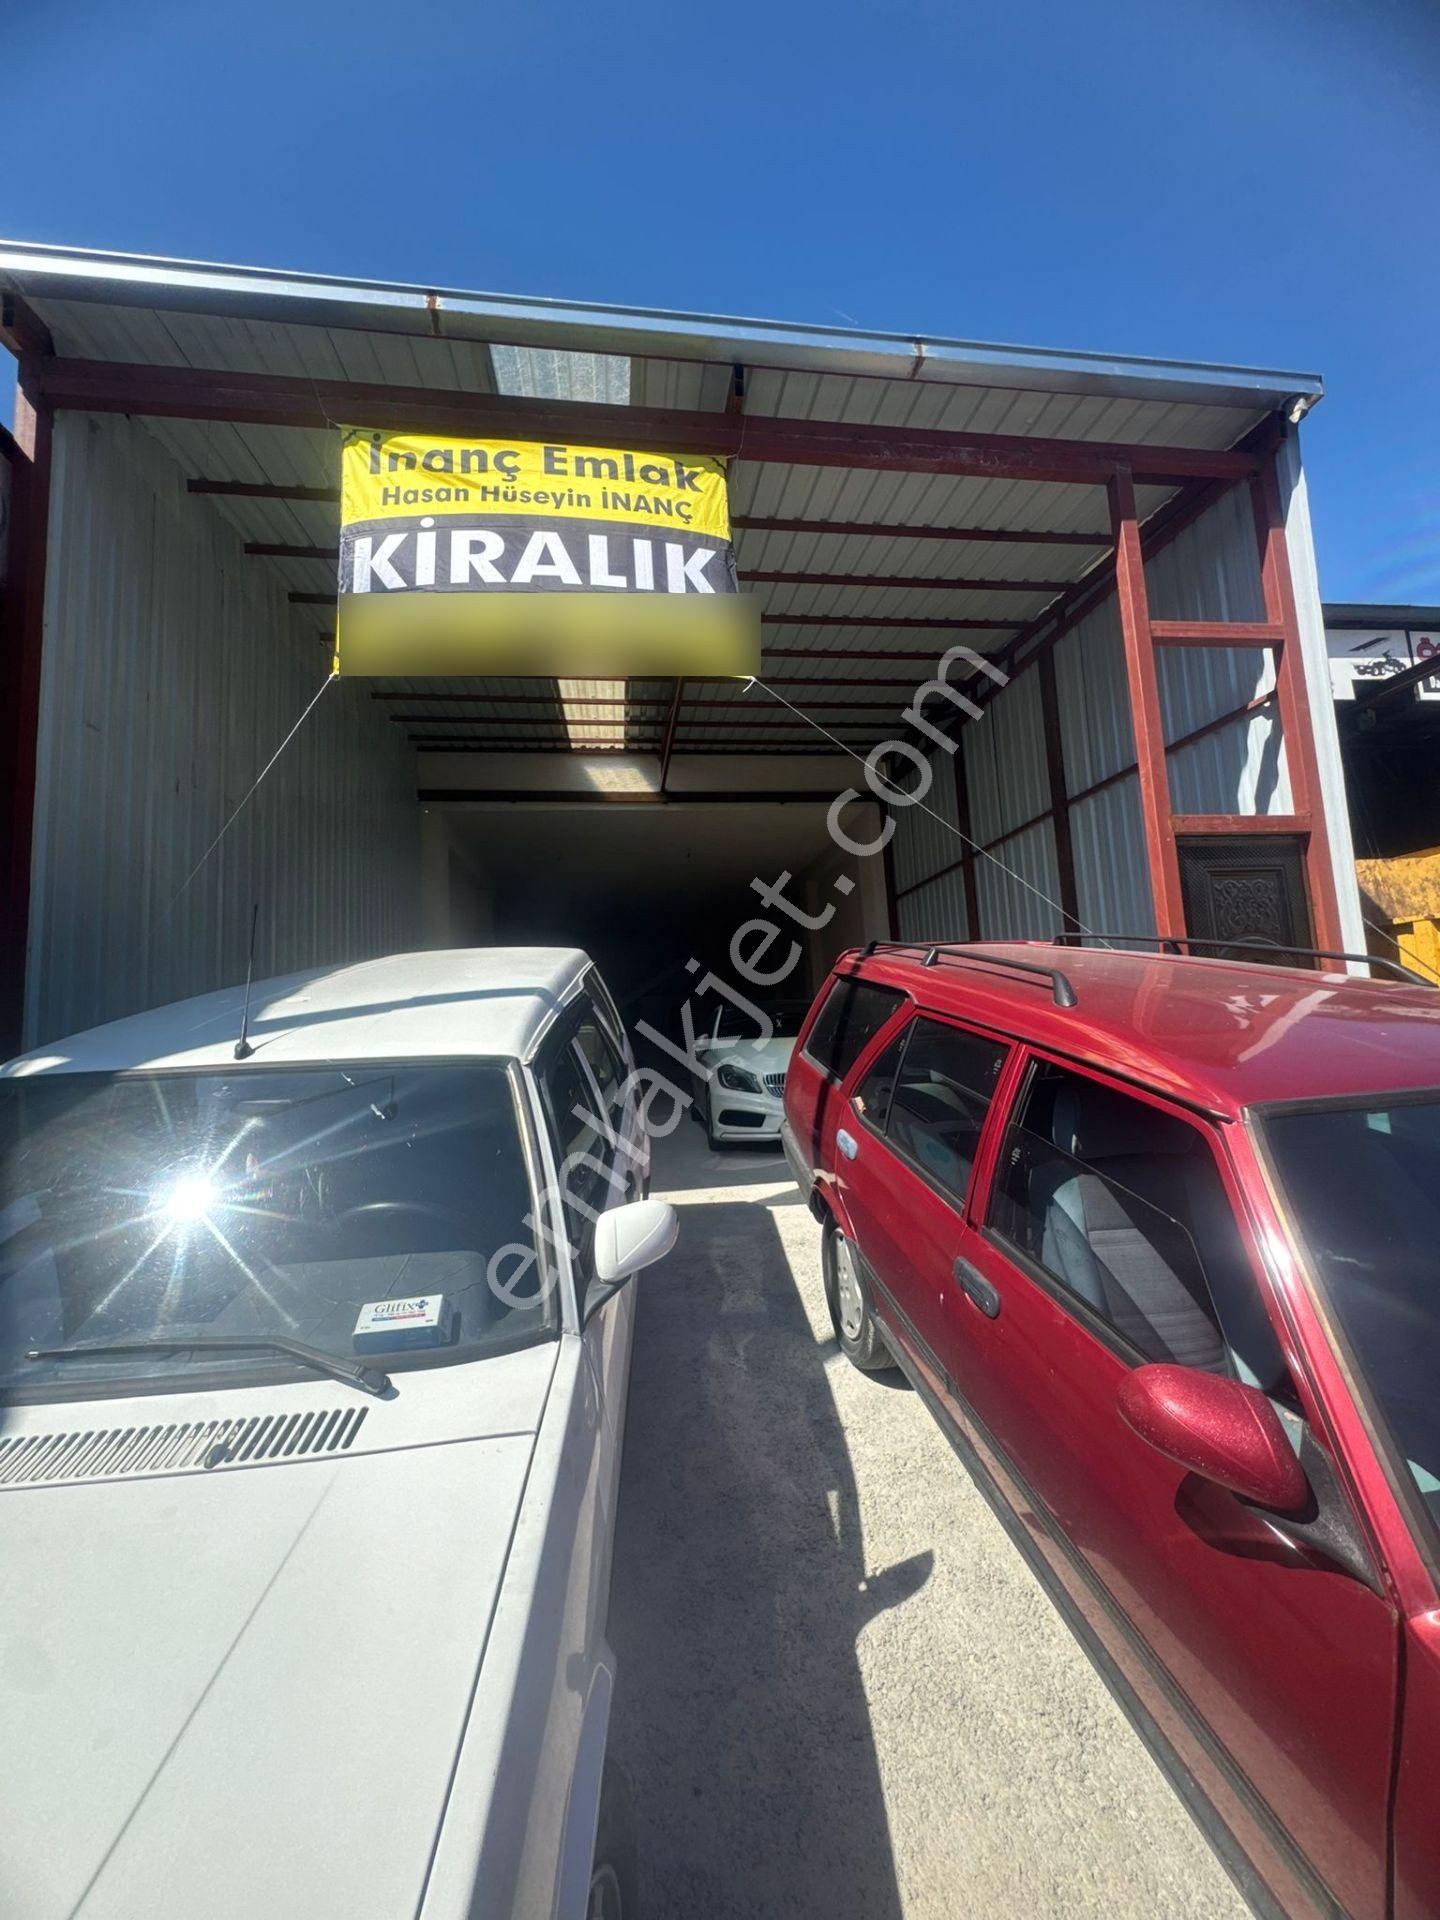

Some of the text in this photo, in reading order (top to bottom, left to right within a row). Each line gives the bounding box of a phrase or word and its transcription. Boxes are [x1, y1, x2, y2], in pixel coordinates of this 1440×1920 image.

[370, 433, 703, 493] İnanç Emlak
[382, 485, 693, 523] Hasan Hüseyin İNANÇ
[353, 517, 716, 593] KİRALIK
